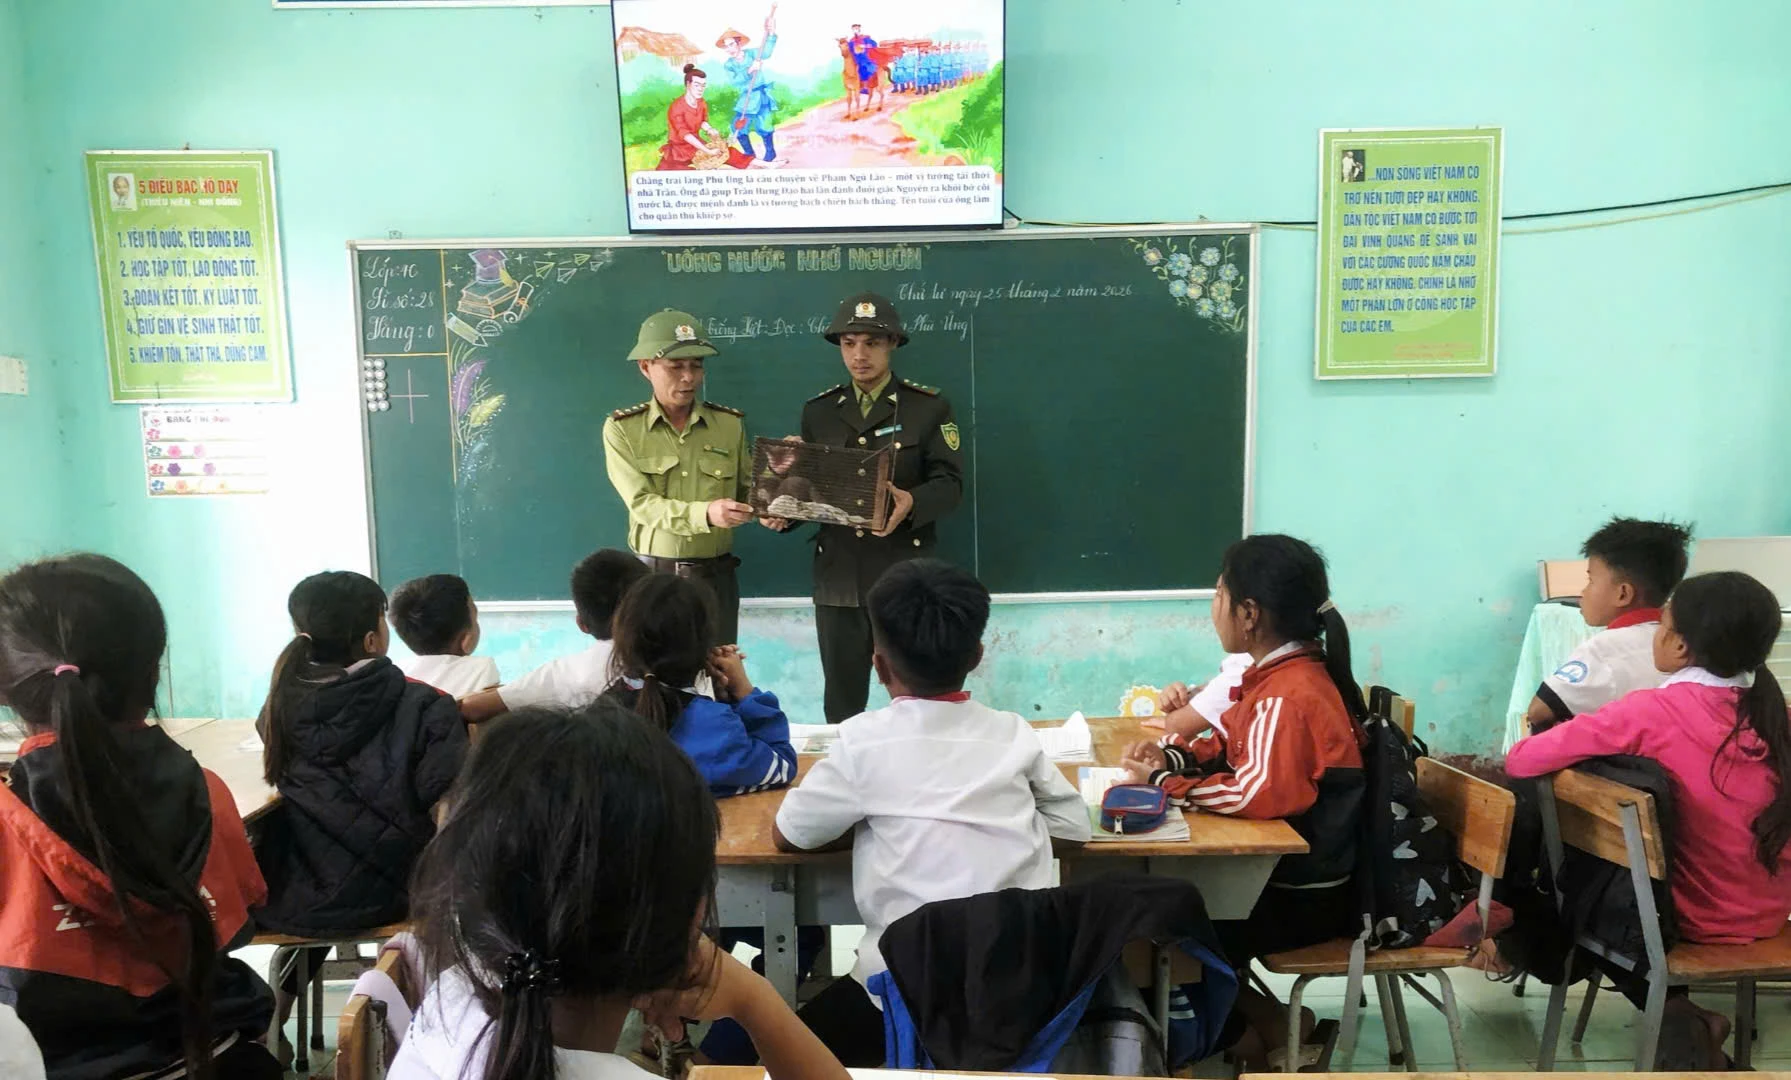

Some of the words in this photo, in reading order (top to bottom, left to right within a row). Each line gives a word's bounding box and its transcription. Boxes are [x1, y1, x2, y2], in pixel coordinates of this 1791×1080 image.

[1444, 166, 1466, 180] NAM
[138, 179, 146, 194] 5
[1427, 190, 1444, 204] HAY
[638, 212, 654, 220] cho
[1402, 212, 1423, 226] NAM
[1362, 234, 1382, 248] VINH
[1386, 234, 1416, 248] QUANG
[1463, 232, 1478, 246] VAI
[727, 245, 786, 273] NƯỚC
[797, 244, 841, 272] NHỚ
[193, 260, 210, 278] LAO
[1008, 280, 1049, 304] tháng
[1101, 284, 1133, 298] 2026
[1366, 278, 1382, 291] HAY
[192, 318, 216, 334] SINH
